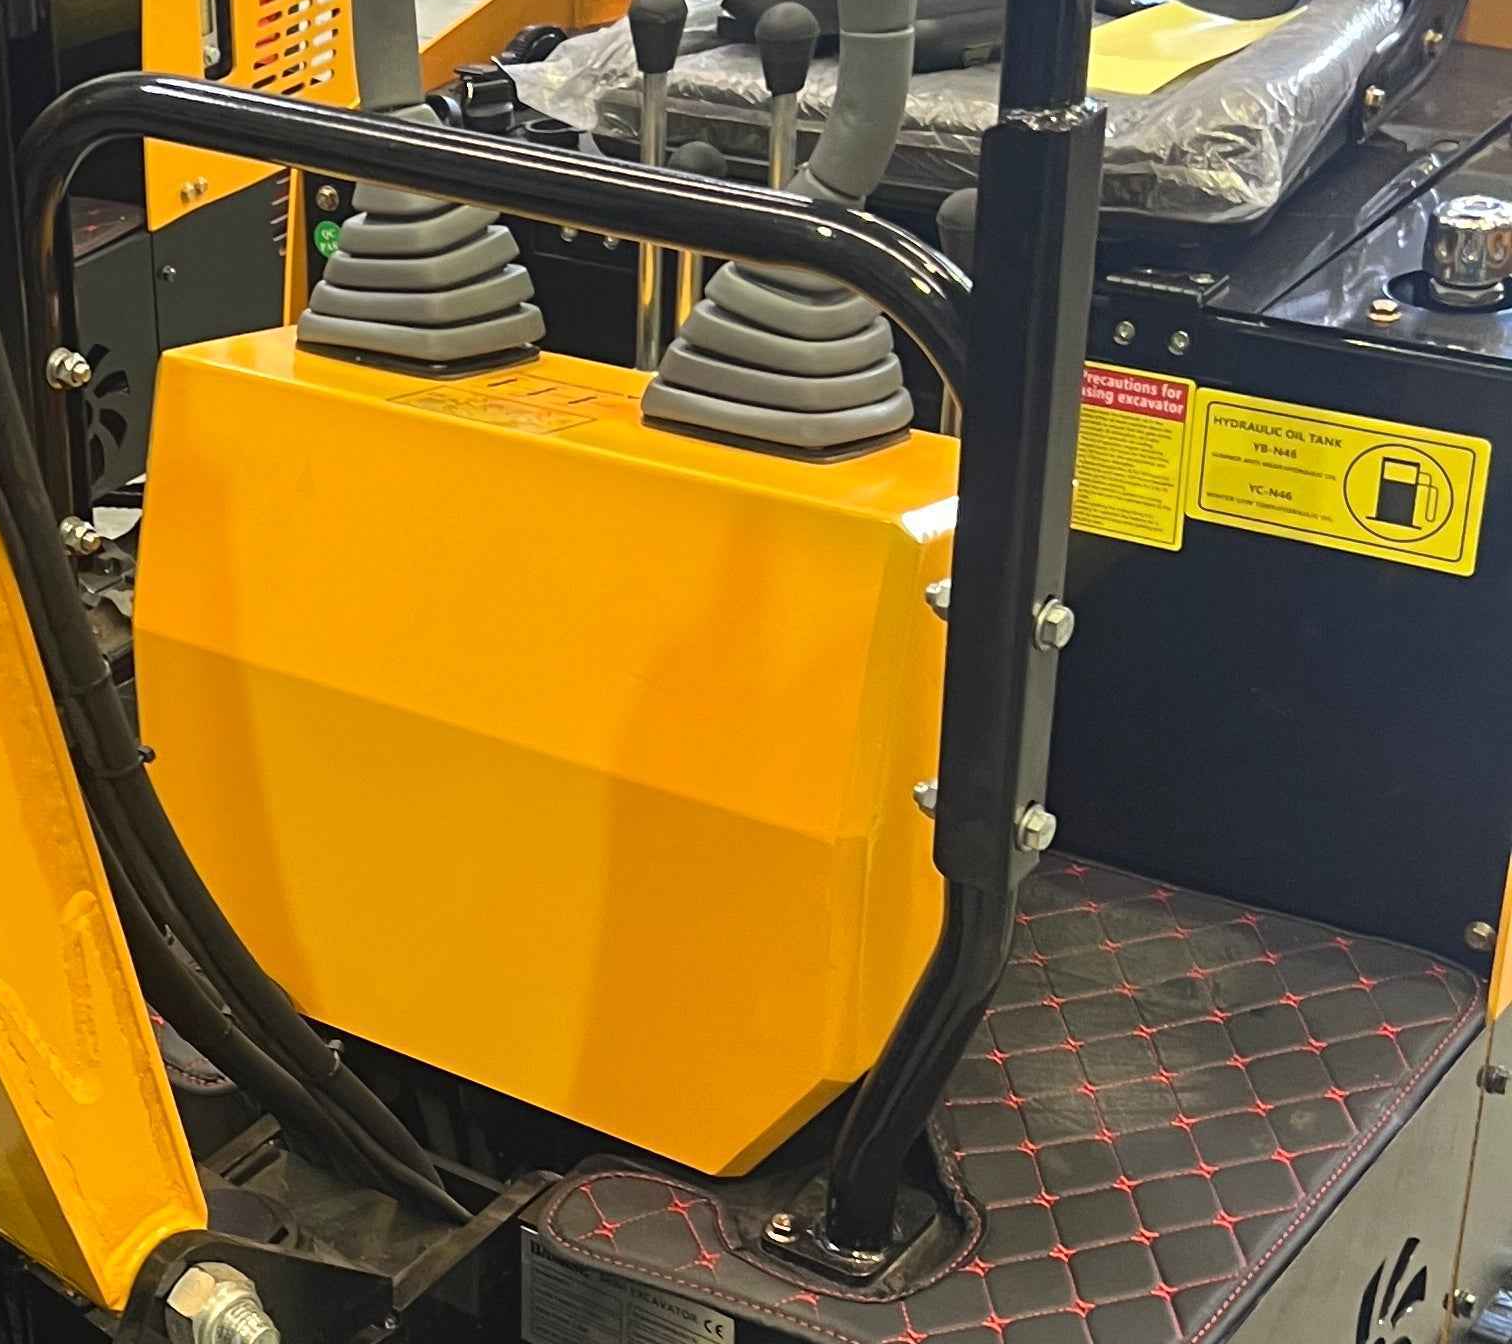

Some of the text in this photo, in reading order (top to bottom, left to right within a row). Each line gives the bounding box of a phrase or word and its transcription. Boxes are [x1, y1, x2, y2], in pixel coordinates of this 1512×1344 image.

[1162, 384, 1182, 400] for
[1117, 393, 1184, 414] excavator
[1213, 416, 1343, 448] HYDRAULIC OIL TANK
[1249, 483, 1293, 501] YC-N46
[703, 1319, 724, 1338] CE
